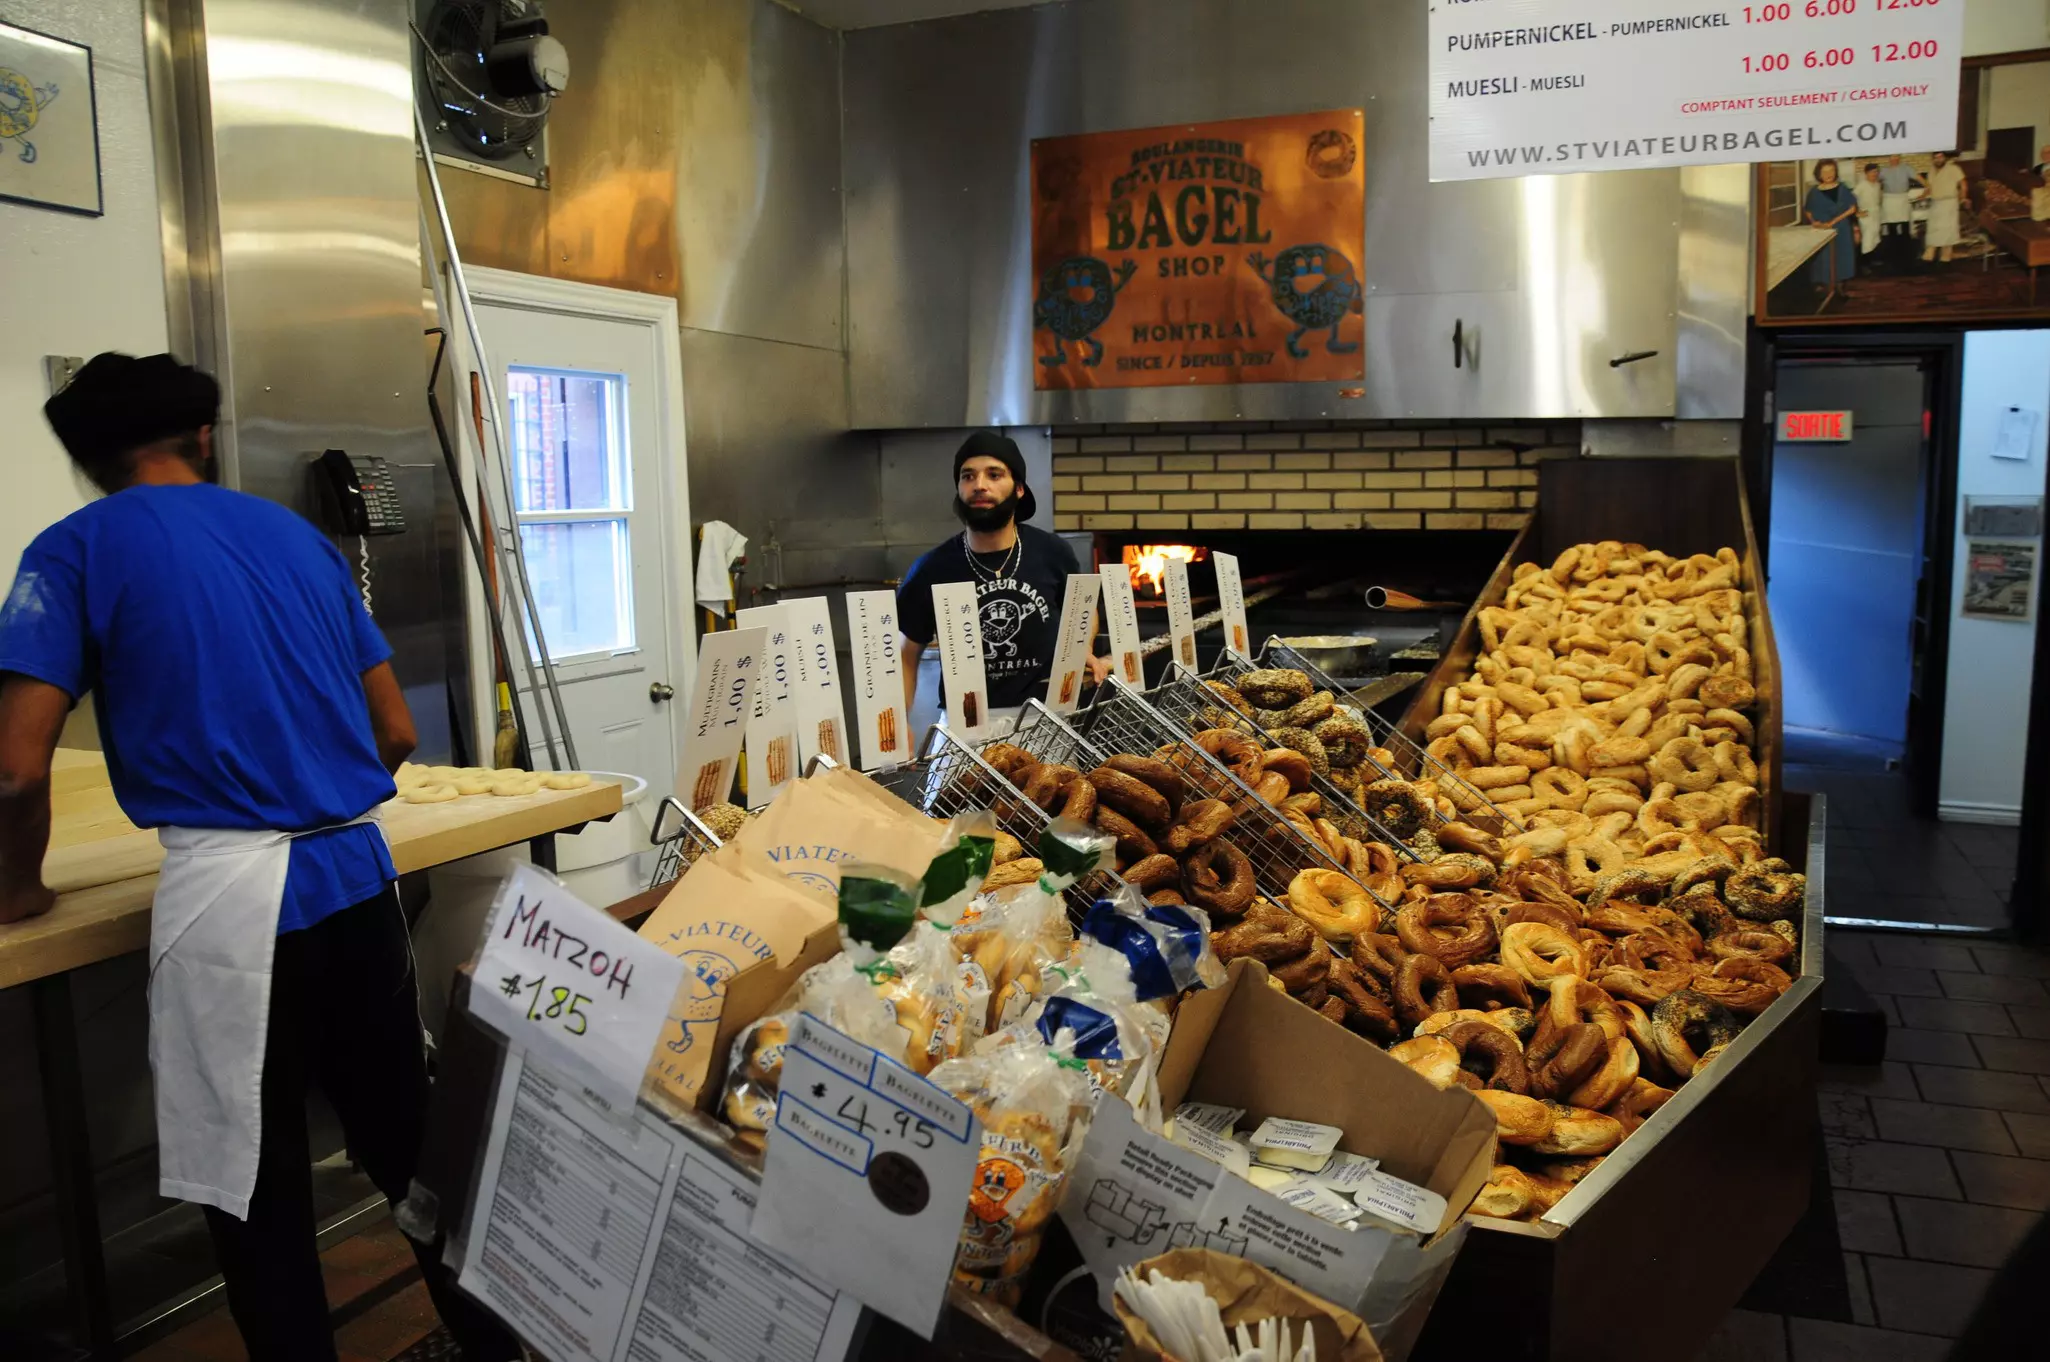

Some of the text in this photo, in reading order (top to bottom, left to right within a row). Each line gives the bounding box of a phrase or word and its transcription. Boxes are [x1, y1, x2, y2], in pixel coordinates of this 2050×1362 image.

[1449, 22, 1597, 52] PUMPERNICKEL
[1611, 13, 1730, 37] PUMPERNICKEL
[1743, 3, 1790, 24] 1.00
[1805, 0, 1856, 18] 6.00
[1742, 40, 1939, 74] 1.00 6.00 12.00
[1448, 77, 1517, 98] MUESLI
[1530, 75, 1585, 92] MUESLI
[1682, 98, 1754, 114] COMPTANT
[1758, 92, 1838, 108] SEULEMENT
[1850, 87, 1888, 101] CASH
[1892, 84, 1930, 98] ONLY
[1468, 121, 1907, 167] WWW.STVIATEURBAGEL.COM
[1106, 185, 1272, 250] BAGEL
[1158, 255, 1226, 278] SHOP
[1116, 355, 1163, 371] SINCE
[1181, 352, 1234, 369] DEPUIS
[1786, 412, 1845, 439] SORTIE
[1019, 582, 1050, 623] BAGEL
[1076, 609, 1090, 645] 1,00
[1084, 594, 1093, 604] $
[1122, 596, 1134, 627] 1,00
[811, 623, 831, 689] 1,00 $
[859, 598, 875, 699] GRAINES DE LIN
[880, 614, 896, 676] 1,00 $
[942, 597, 958, 676] PUMPERNICKEL
[960, 603, 976, 660] 1,00 $
[772, 632, 789, 702] 1,00 $
[796, 638, 808, 682] MUESLI
[698, 658, 721, 738] MULTIGRAINS
[709, 664, 729, 729] MULTIGRAIN
[724, 655, 752, 728] 1,00 $
[503, 895, 634, 1000] MATZOH
[801, 1027, 956, 1123] BAGELETTE BAGELETTE
[790, 1110, 856, 1157] BAGELETTE
[837, 1095, 938, 1149] 4.95
[1264, 1136, 1313, 1151] PHILADELPHIA
[1174, 1165, 1215, 1191] Packaging
[1366, 1195, 1416, 1221] PHILADELPHIA
